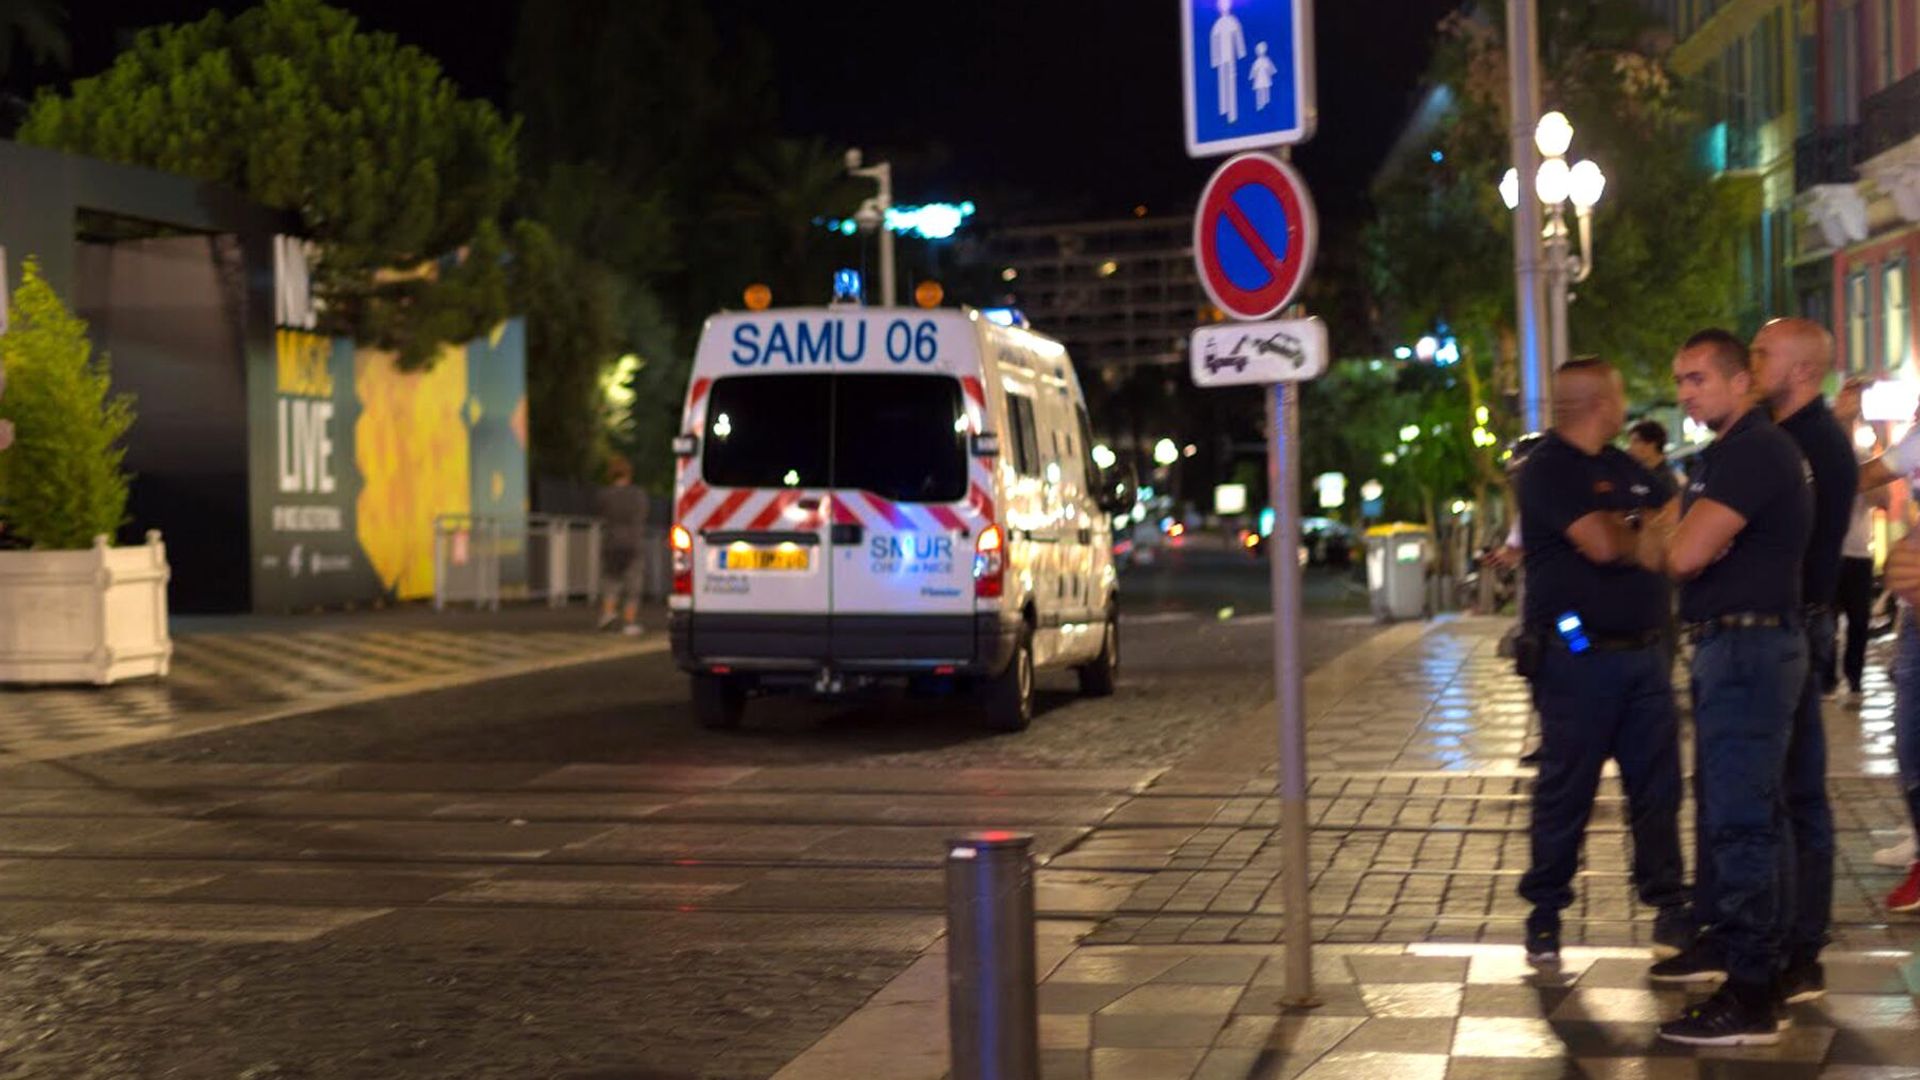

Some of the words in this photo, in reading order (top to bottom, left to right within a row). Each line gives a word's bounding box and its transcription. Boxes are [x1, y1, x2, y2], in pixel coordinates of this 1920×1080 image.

[732, 319, 867, 366] SAMU
[886, 319, 938, 363] 06
[278, 399, 335, 493] LIVE
[870, 535, 953, 559] SMUR
